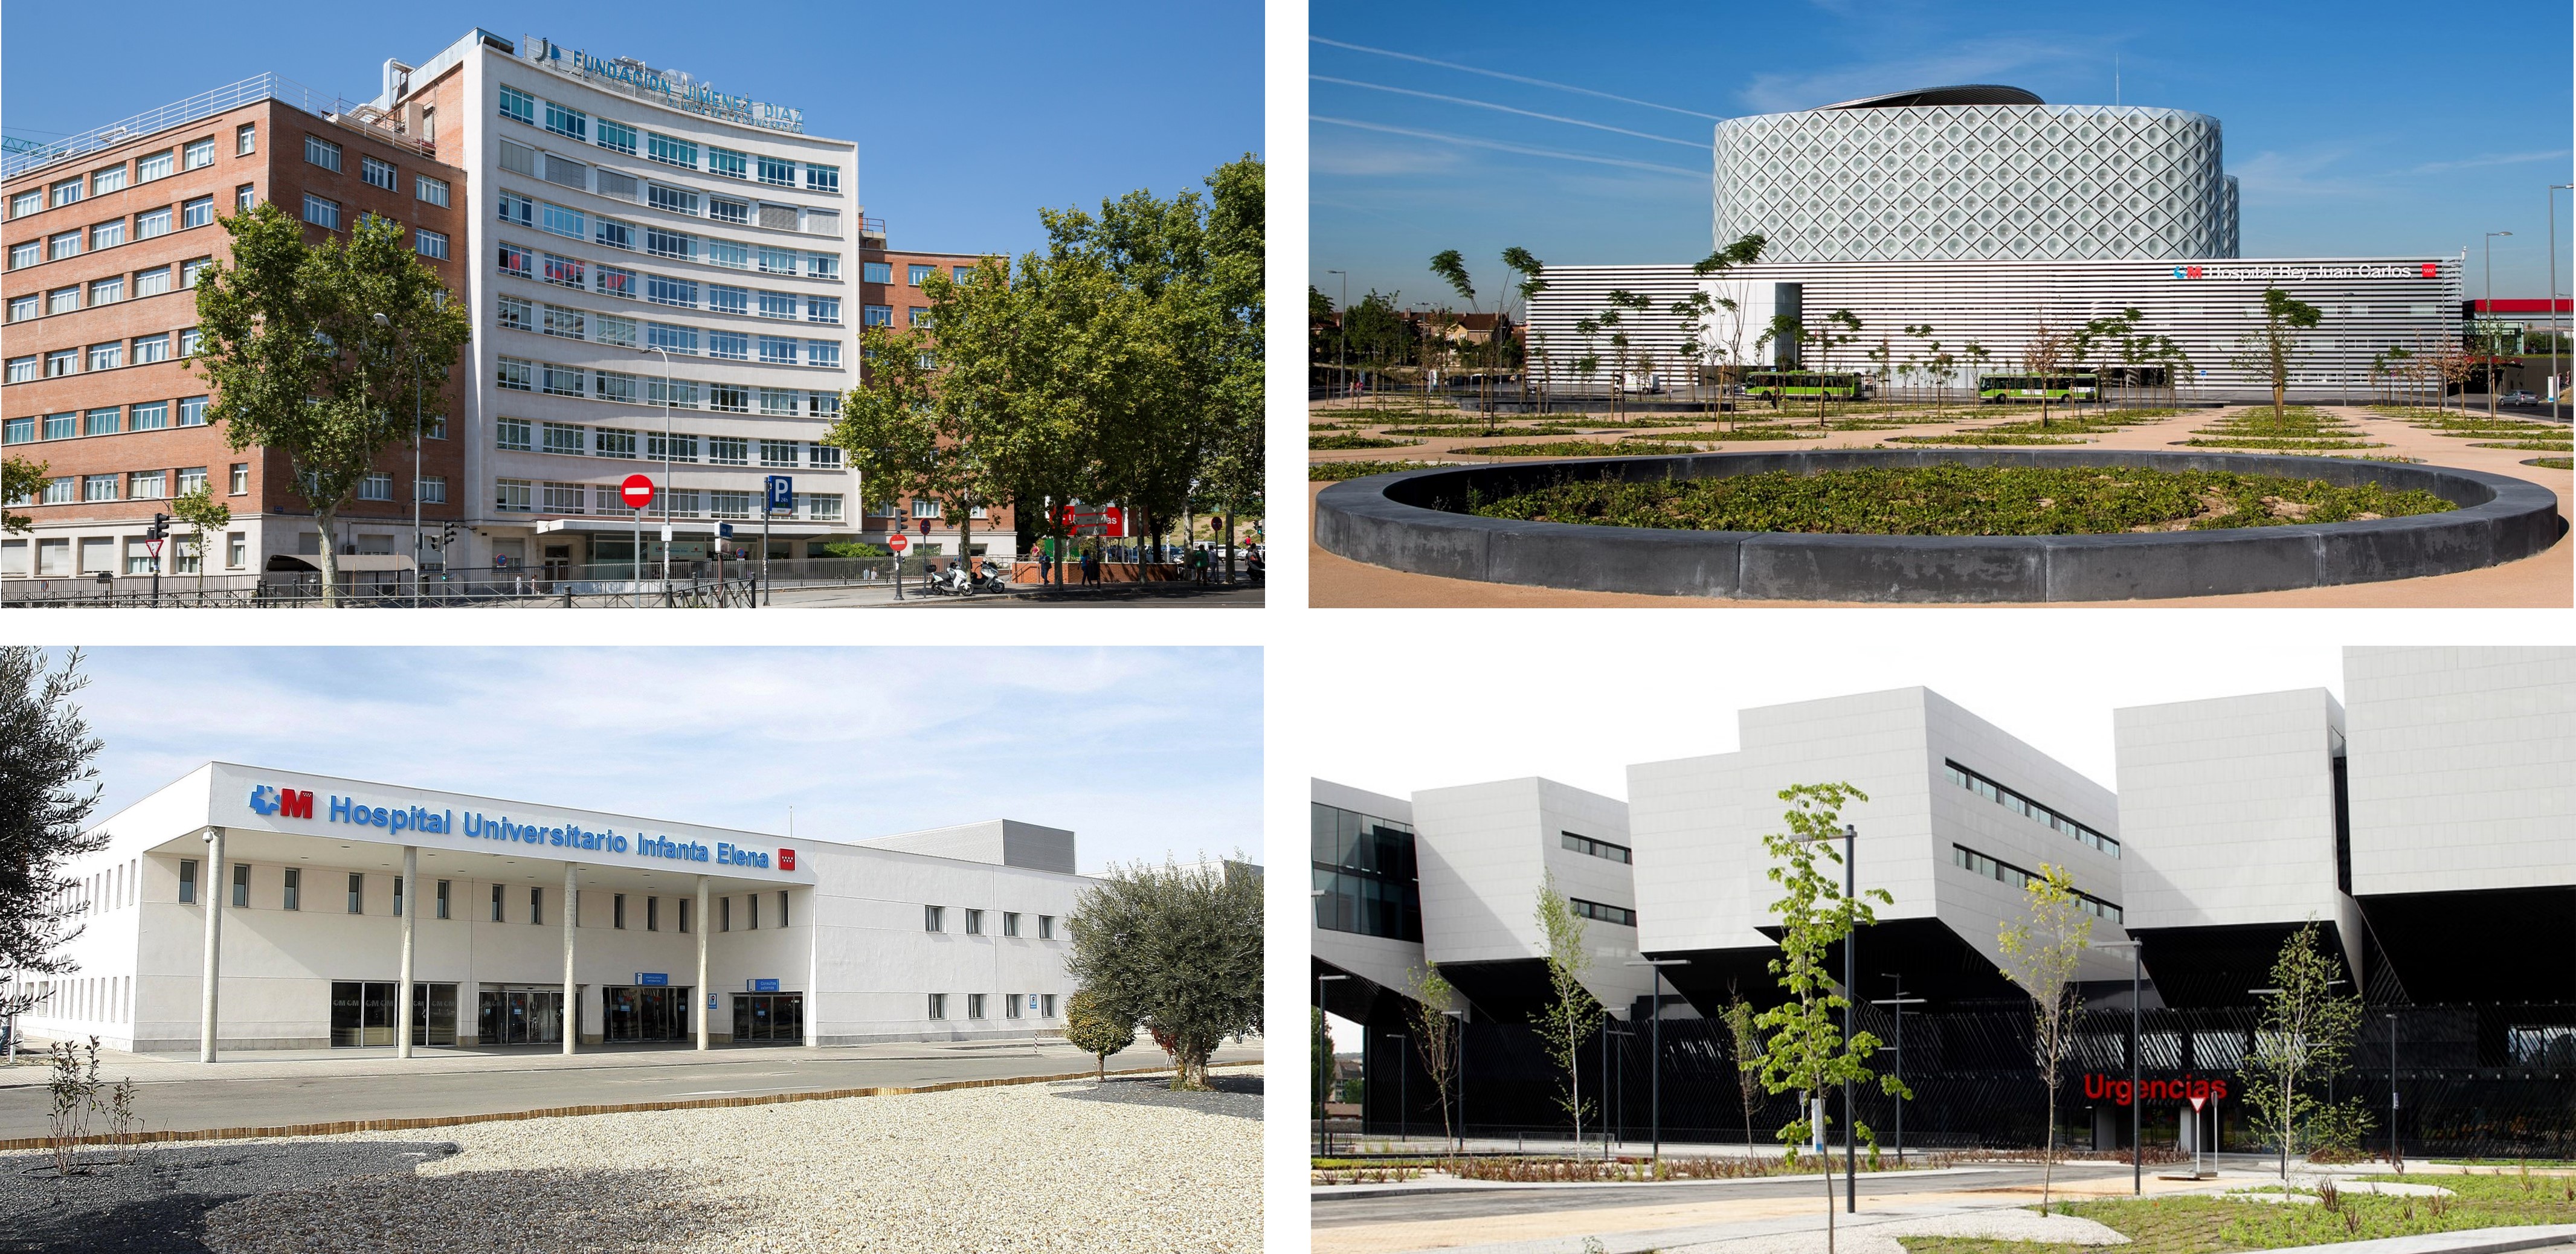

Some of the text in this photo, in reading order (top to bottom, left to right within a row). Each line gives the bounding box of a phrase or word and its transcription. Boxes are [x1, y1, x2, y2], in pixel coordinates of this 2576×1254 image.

[667, 98, 706, 115] CLINICA
[710, 108, 722, 119] DE
[726, 112, 739, 123] LA
[2209, 266, 2272, 283] Hospital
[2279, 266, 2310, 281] Rey
[2314, 265, 2353, 278] Juan
[2359, 263, 2412, 278] Carlos
[775, 479, 788, 502] P
[329, 795, 451, 835] Hospital
[463, 811, 628, 853] Universitario
[636, 832, 709, 863] Infanta
[715, 842, 769, 868] Elena
[2084, 1073, 2227, 1105] Urgencias
